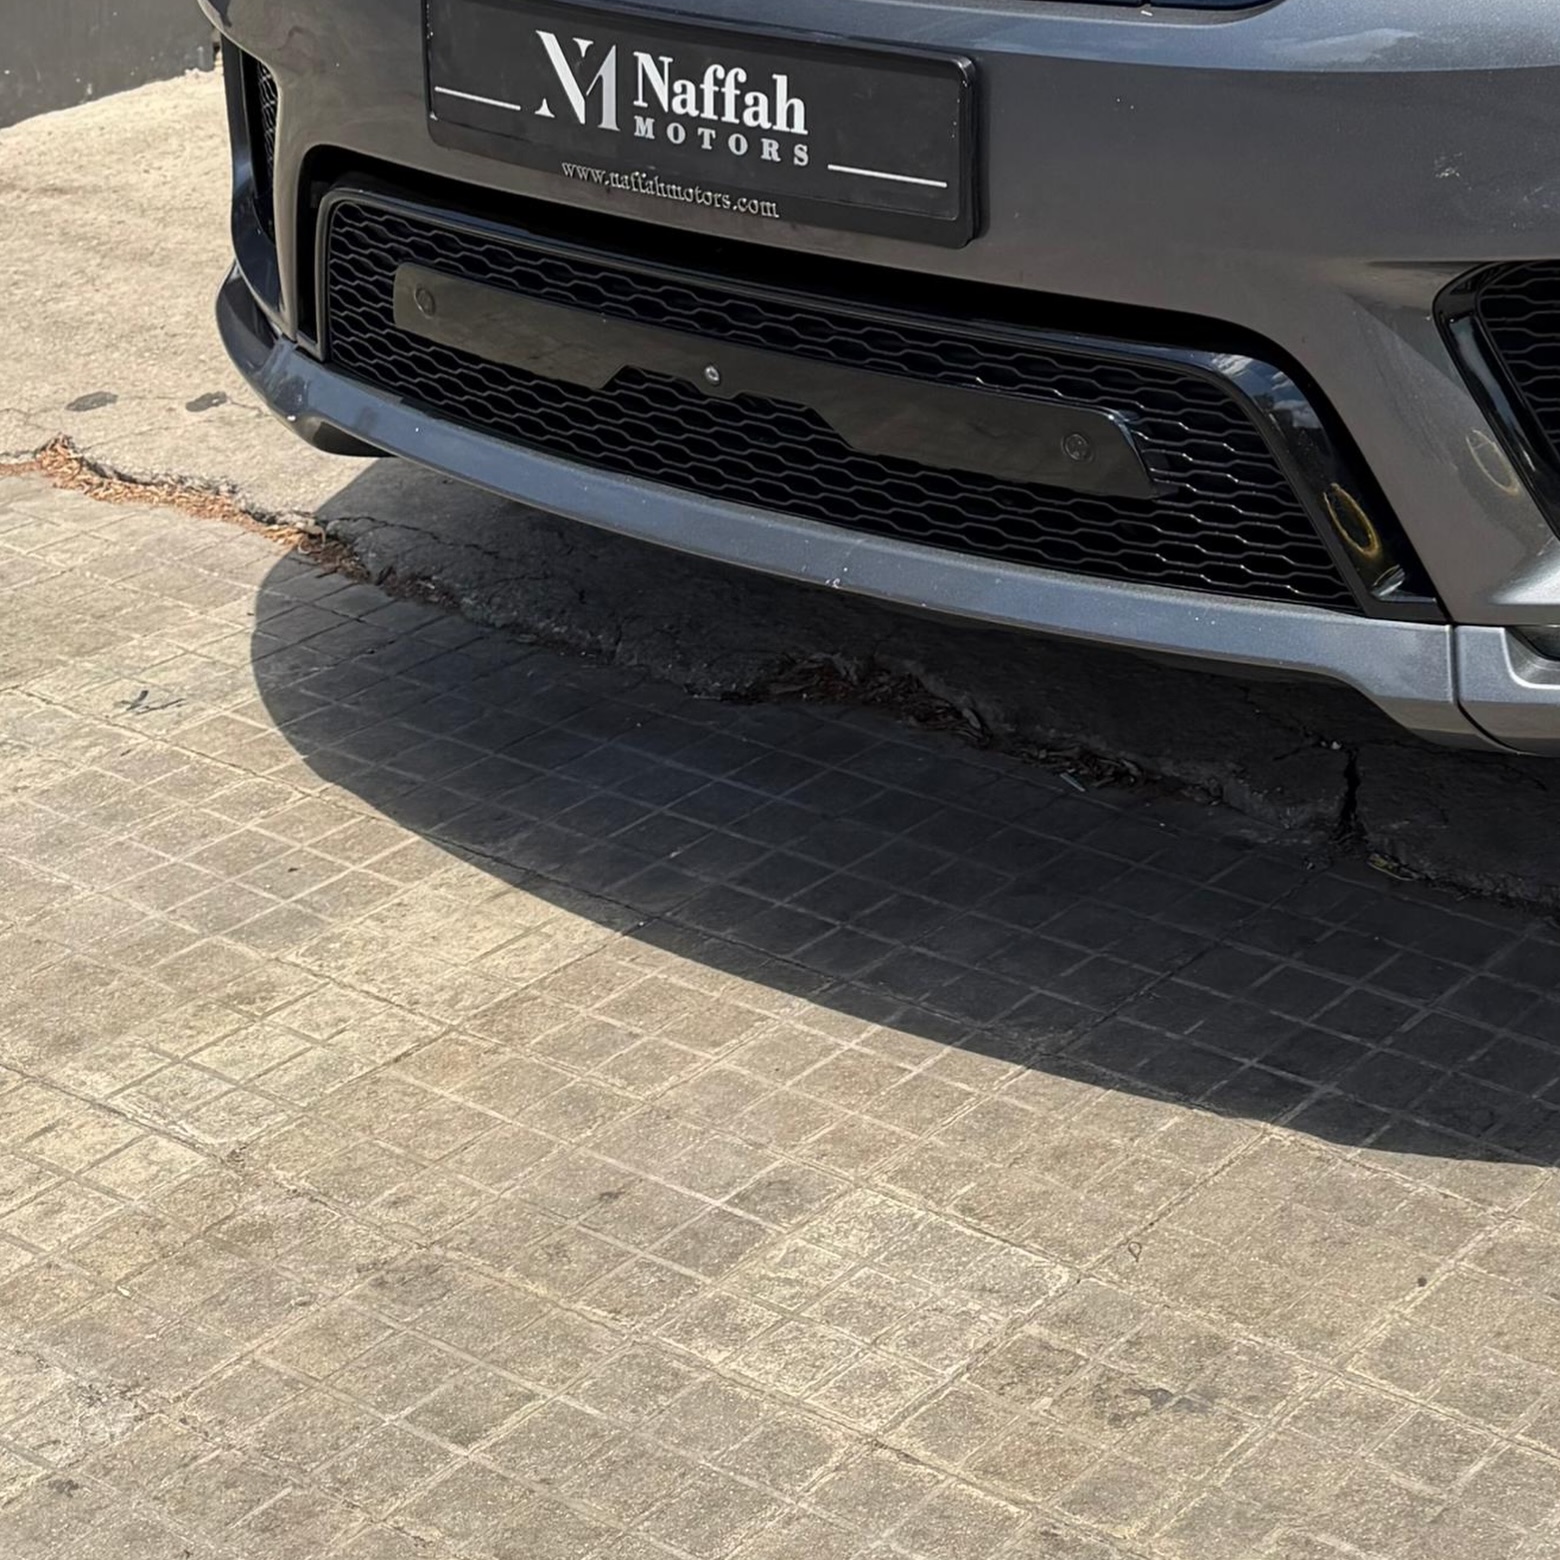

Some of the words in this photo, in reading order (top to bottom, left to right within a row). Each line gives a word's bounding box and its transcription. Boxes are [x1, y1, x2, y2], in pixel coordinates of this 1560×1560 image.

[632, 50, 809, 135] Naffah
[633, 115, 810, 167] MOTORS
[561, 162, 779, 218] www.naffahmotors.com
